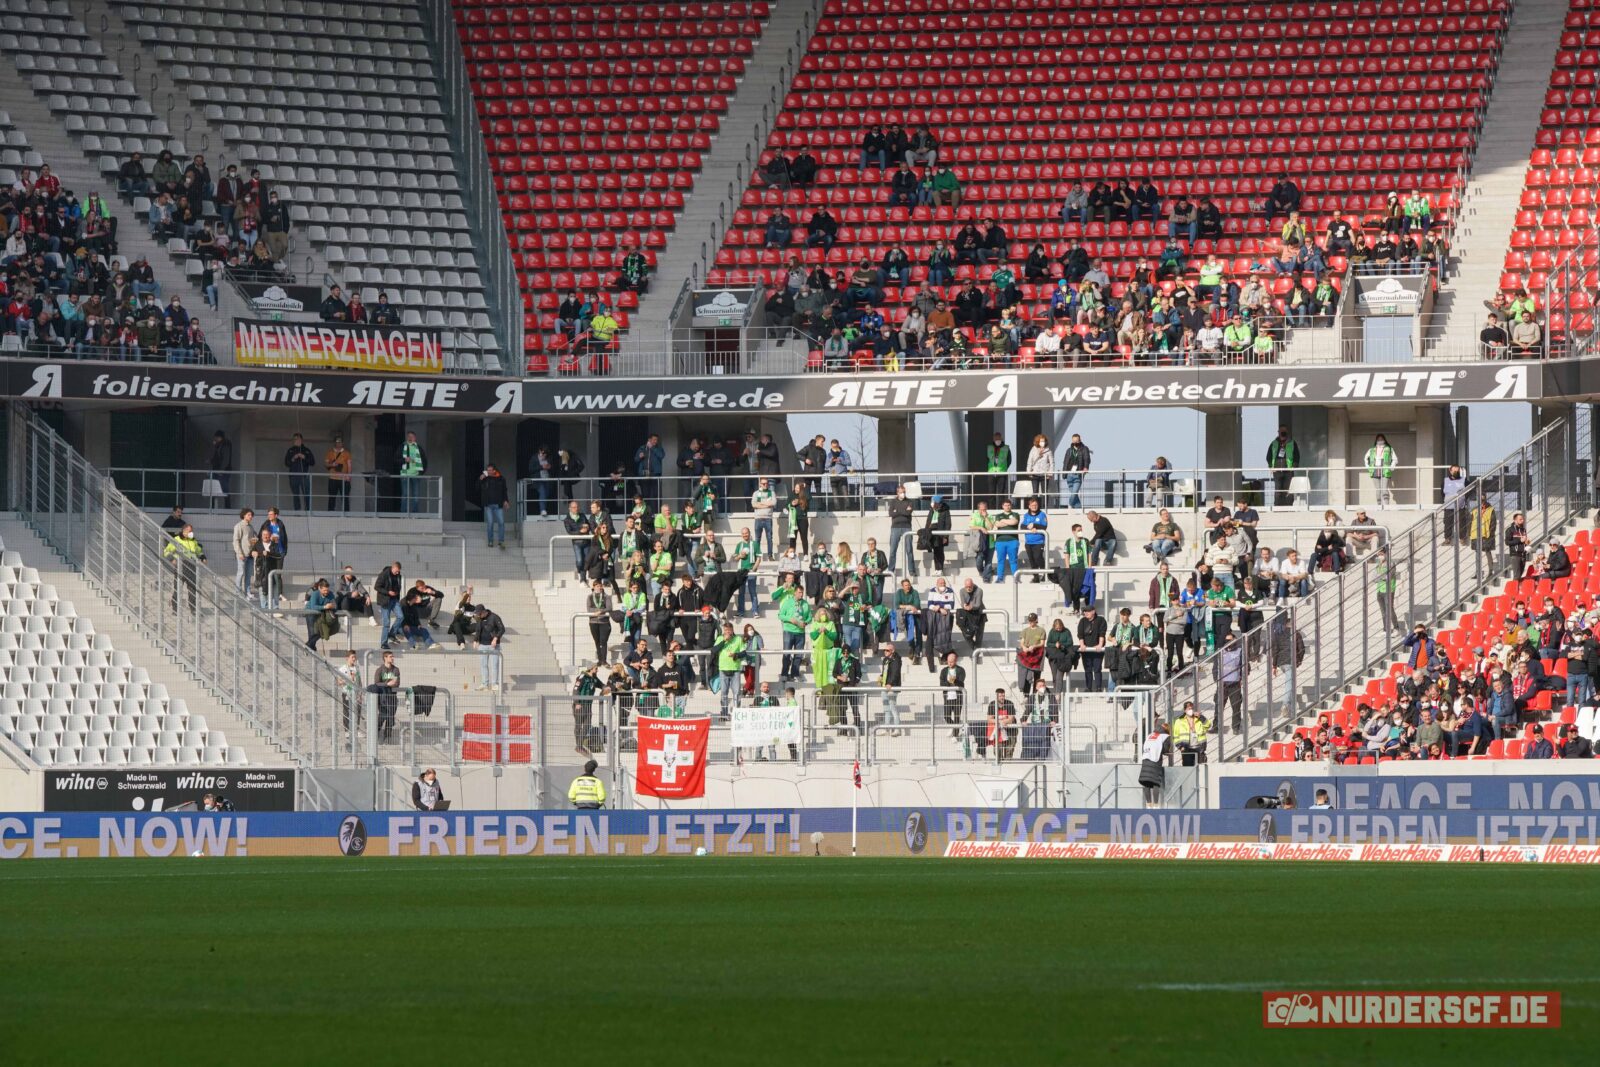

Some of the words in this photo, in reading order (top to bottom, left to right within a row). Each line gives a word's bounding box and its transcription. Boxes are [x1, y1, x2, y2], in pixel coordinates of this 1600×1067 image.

[239, 322, 440, 367] MEINERZHAGEN
[92, 374, 322, 403] folientechnik
[1046, 378, 1309, 402] werbetechnik
[553, 388, 784, 410] www.rete.de
[650, 723, 697, 731] ALPEN-WÖLFE
[56, 773, 95, 790] wiha
[118, 781, 167, 790] Schwarzwald
[126, 774, 147, 782] Made
[148, 774, 158, 782] im
[176, 772, 215, 789] wiha
[237, 780, 285, 789] Schwarzwald
[245, 773, 265, 781] Made
[100, 816, 248, 857] NOW!
[388, 815, 626, 856] FRIEDEN.
[642, 814, 800, 855] JETZT!
[948, 841, 1020, 857] WeberHaus
[1025, 842, 1098, 859] WeberHaus
[1103, 843, 1180, 859] WeberHaus
[1186, 843, 1261, 860] WeberHau
[1272, 843, 1354, 860] WeberHaus
[1359, 844, 1443, 861] WeberHaus
[1449, 845, 1538, 862] WeberHau
